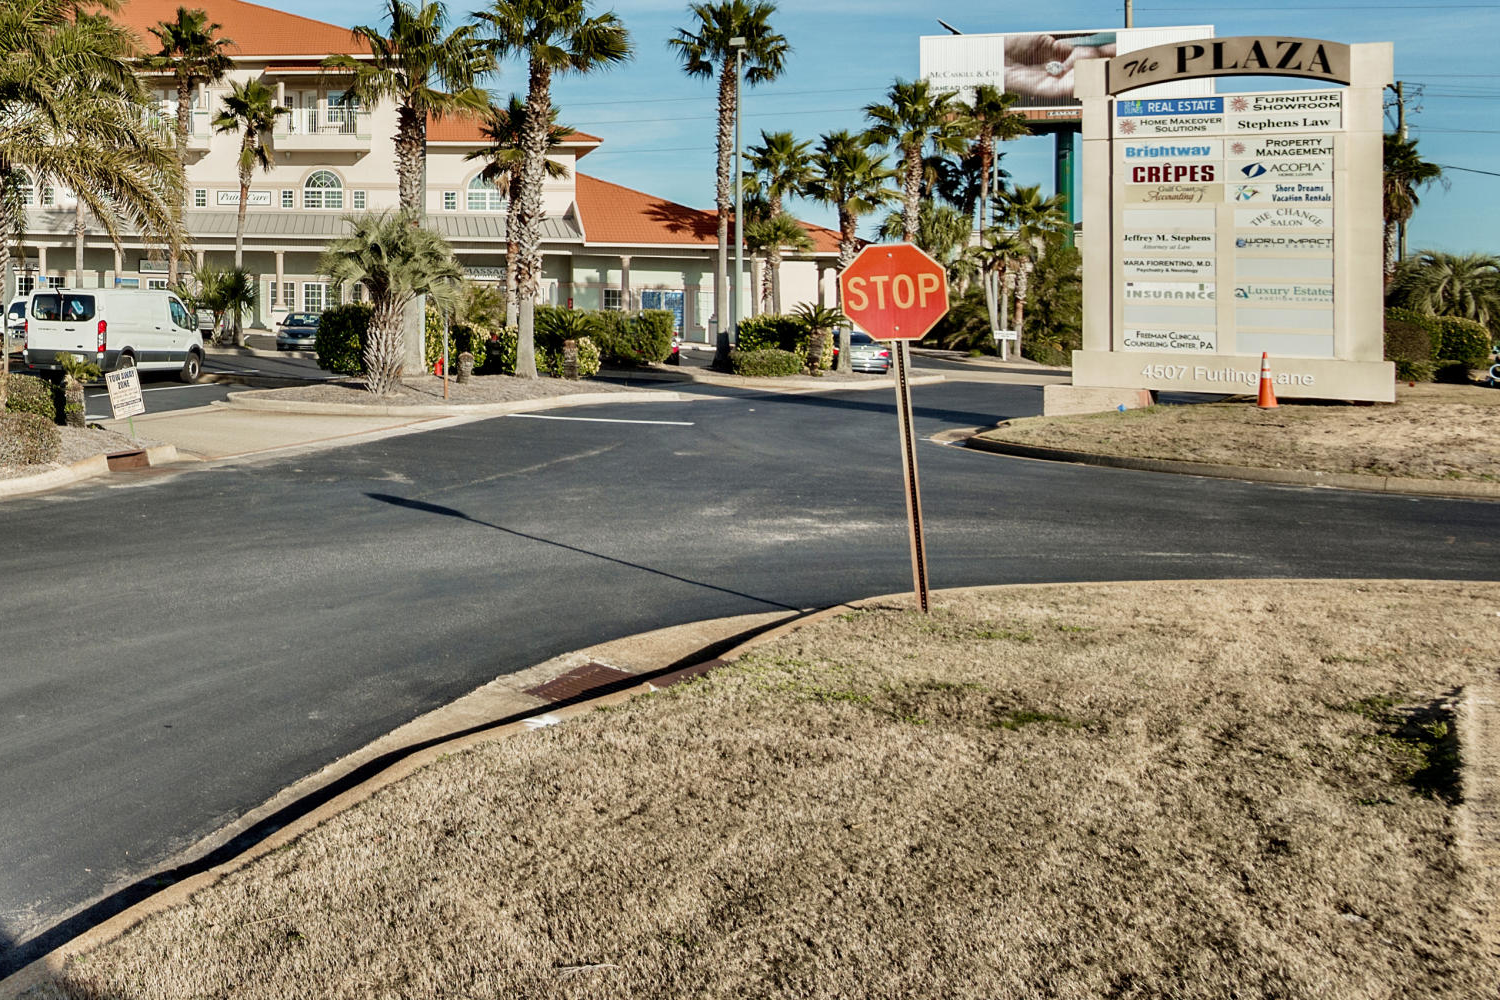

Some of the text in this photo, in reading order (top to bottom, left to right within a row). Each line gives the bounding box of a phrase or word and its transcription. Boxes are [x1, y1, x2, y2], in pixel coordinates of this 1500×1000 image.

[1123, 40, 1335, 78] The PLAZA
[1255, 94, 1338, 104] FURNITURE
[1148, 100, 1216, 113] REAL ESTATE
[1253, 102, 1340, 111] SHOWROOM
[1169, 117, 1222, 126] MAKEOVER
[1238, 118, 1330, 130] Stephens Law
[1155, 125, 1207, 133] SOLUTIONS
[1266, 139, 1322, 148] PROPERTY
[1125, 146, 1211, 158] Brightway
[1256, 147, 1333, 157] MANAGEMENT
[1132, 162, 1214, 183] CRÊPES
[1270, 163, 1322, 173] ACOPIA
[1275, 184, 1324, 192] Shore Dreams
[1142, 190, 1194, 203] Accounting
[1272, 193, 1331, 202] Vacation Rentals
[1250, 208, 1324, 227] THE CHANGE
[1270, 219, 1303, 227] SALON
[1124, 234, 1152, 243] Jeffrey
[1171, 234, 1211, 243] Stephens
[1147, 260, 1195, 268] FIORENTINO,
[847, 273, 940, 311] STOP
[1126, 290, 1215, 300] INSURANCE
[1247, 285, 1333, 297] Luxury Estates
[1136, 330, 1201, 341] FREEMAN CLINICAL
[1124, 339, 1168, 348] COUNSELING
[1200, 341, 1213, 350] PA
[109, 371, 134, 382] TOW AWAY
[1141, 364, 1188, 380] 4507
[1193, 366, 1259, 387] Furling
[118, 380, 130, 389] ZONE
